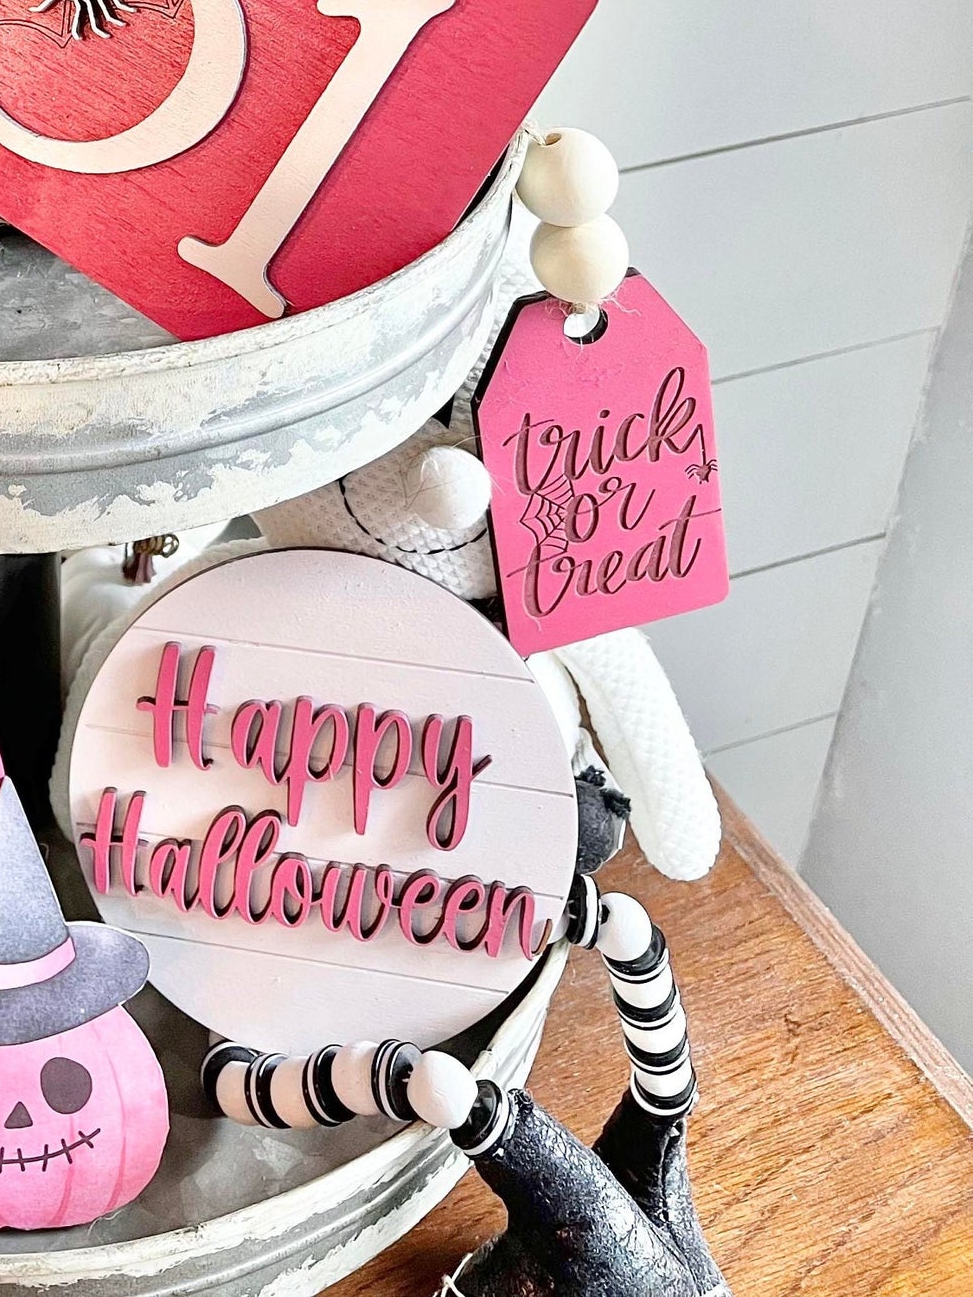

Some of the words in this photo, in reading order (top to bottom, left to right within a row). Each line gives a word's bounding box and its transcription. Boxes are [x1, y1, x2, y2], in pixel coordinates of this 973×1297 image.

[502, 366, 701, 496] trick
[506, 494, 722, 619] treat
[565, 476, 656, 544] or
[135, 640, 493, 851] Happy
[80, 786, 554, 961] Halloween
